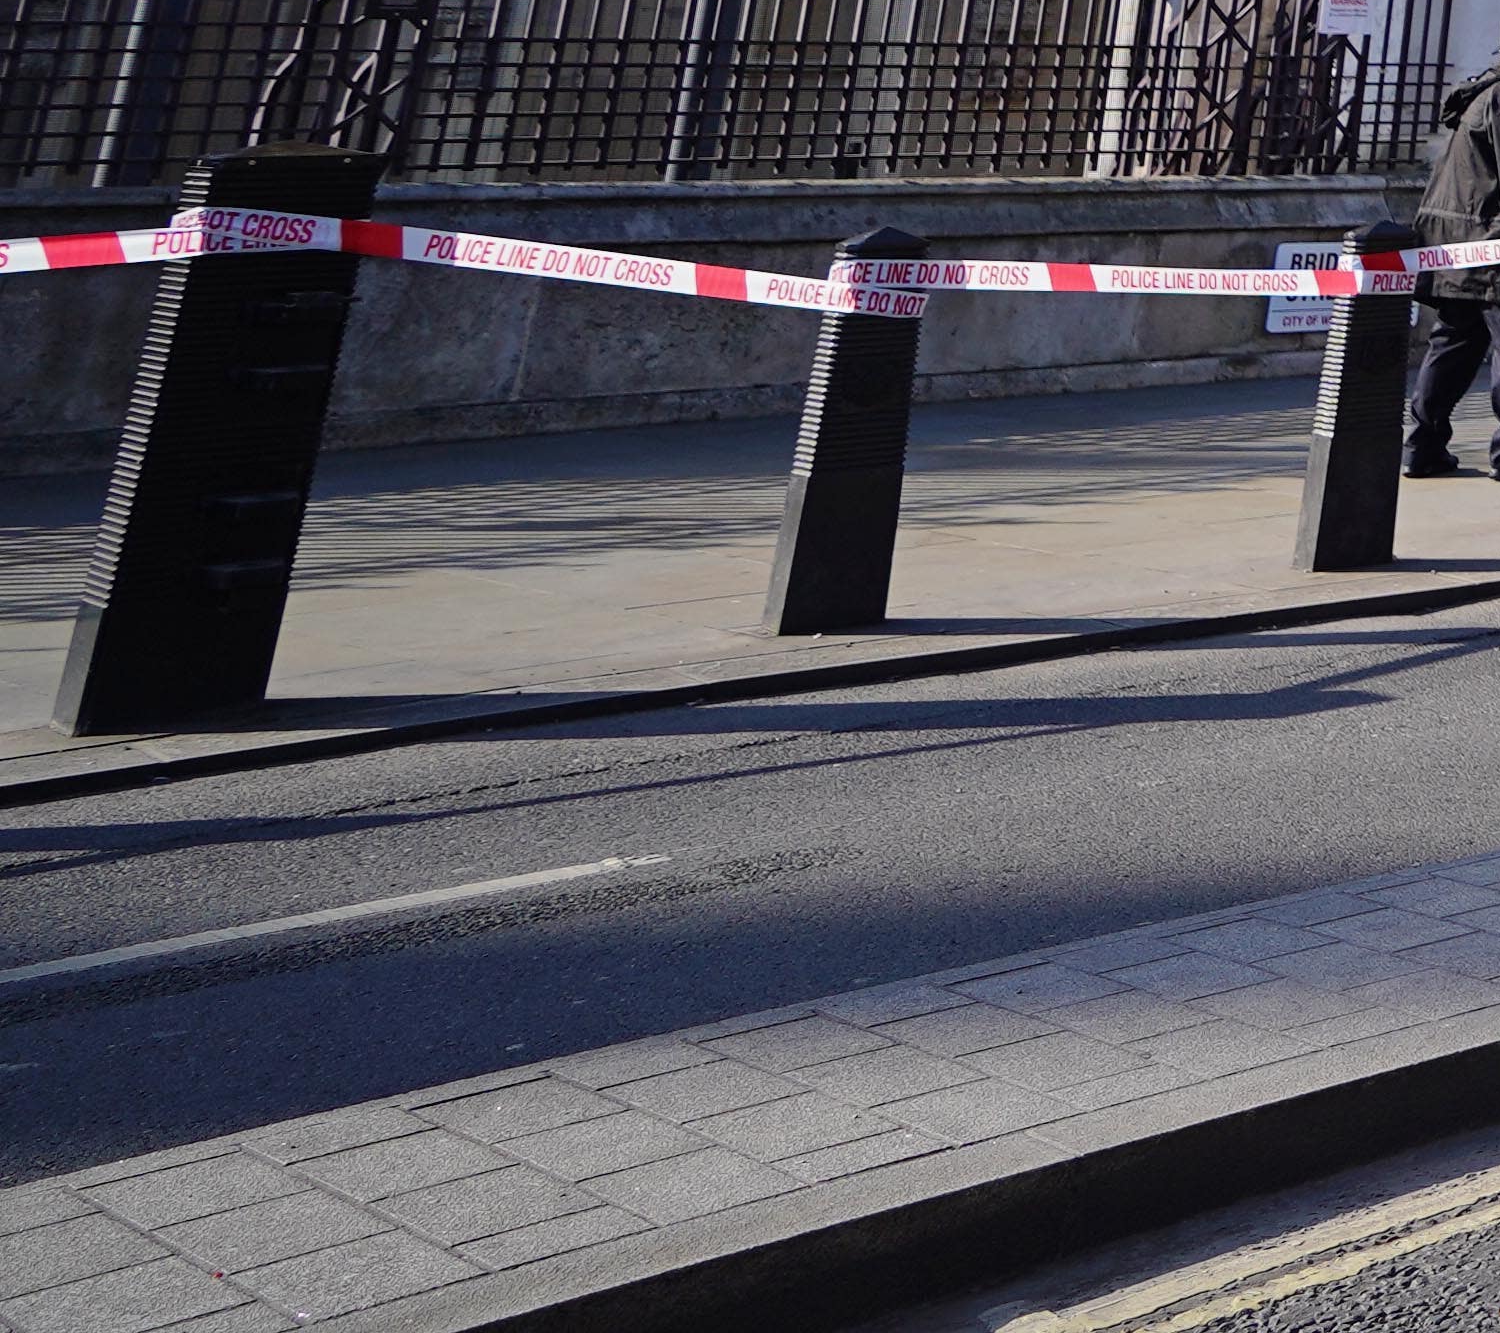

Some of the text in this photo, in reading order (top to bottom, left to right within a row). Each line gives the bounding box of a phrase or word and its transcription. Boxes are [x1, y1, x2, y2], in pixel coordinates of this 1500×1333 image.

[242, 213, 318, 244] CROSS
[152, 230, 235, 255] POLICE
[424, 233, 675, 287] POLICE LINE DO NOT CROSS
[1289, 252, 1340, 271] BRID
[1418, 244, 1462, 269] POLICE
[1463, 242, 1491, 264] LINE
[876, 262, 918, 284] LINE
[917, 263, 942, 284] DO
[943, 264, 975, 284] NOT
[978, 264, 1030, 286] CROSS
[1111, 269, 1299, 292] POLICE LINE DO NOT CROSS
[1371, 274, 1415, 292] POLICE
[766, 278, 926, 316] POLICE LINE DO NOT
[1282, 315, 1303, 327] CITY
[1305, 315, 1318, 326] OF
